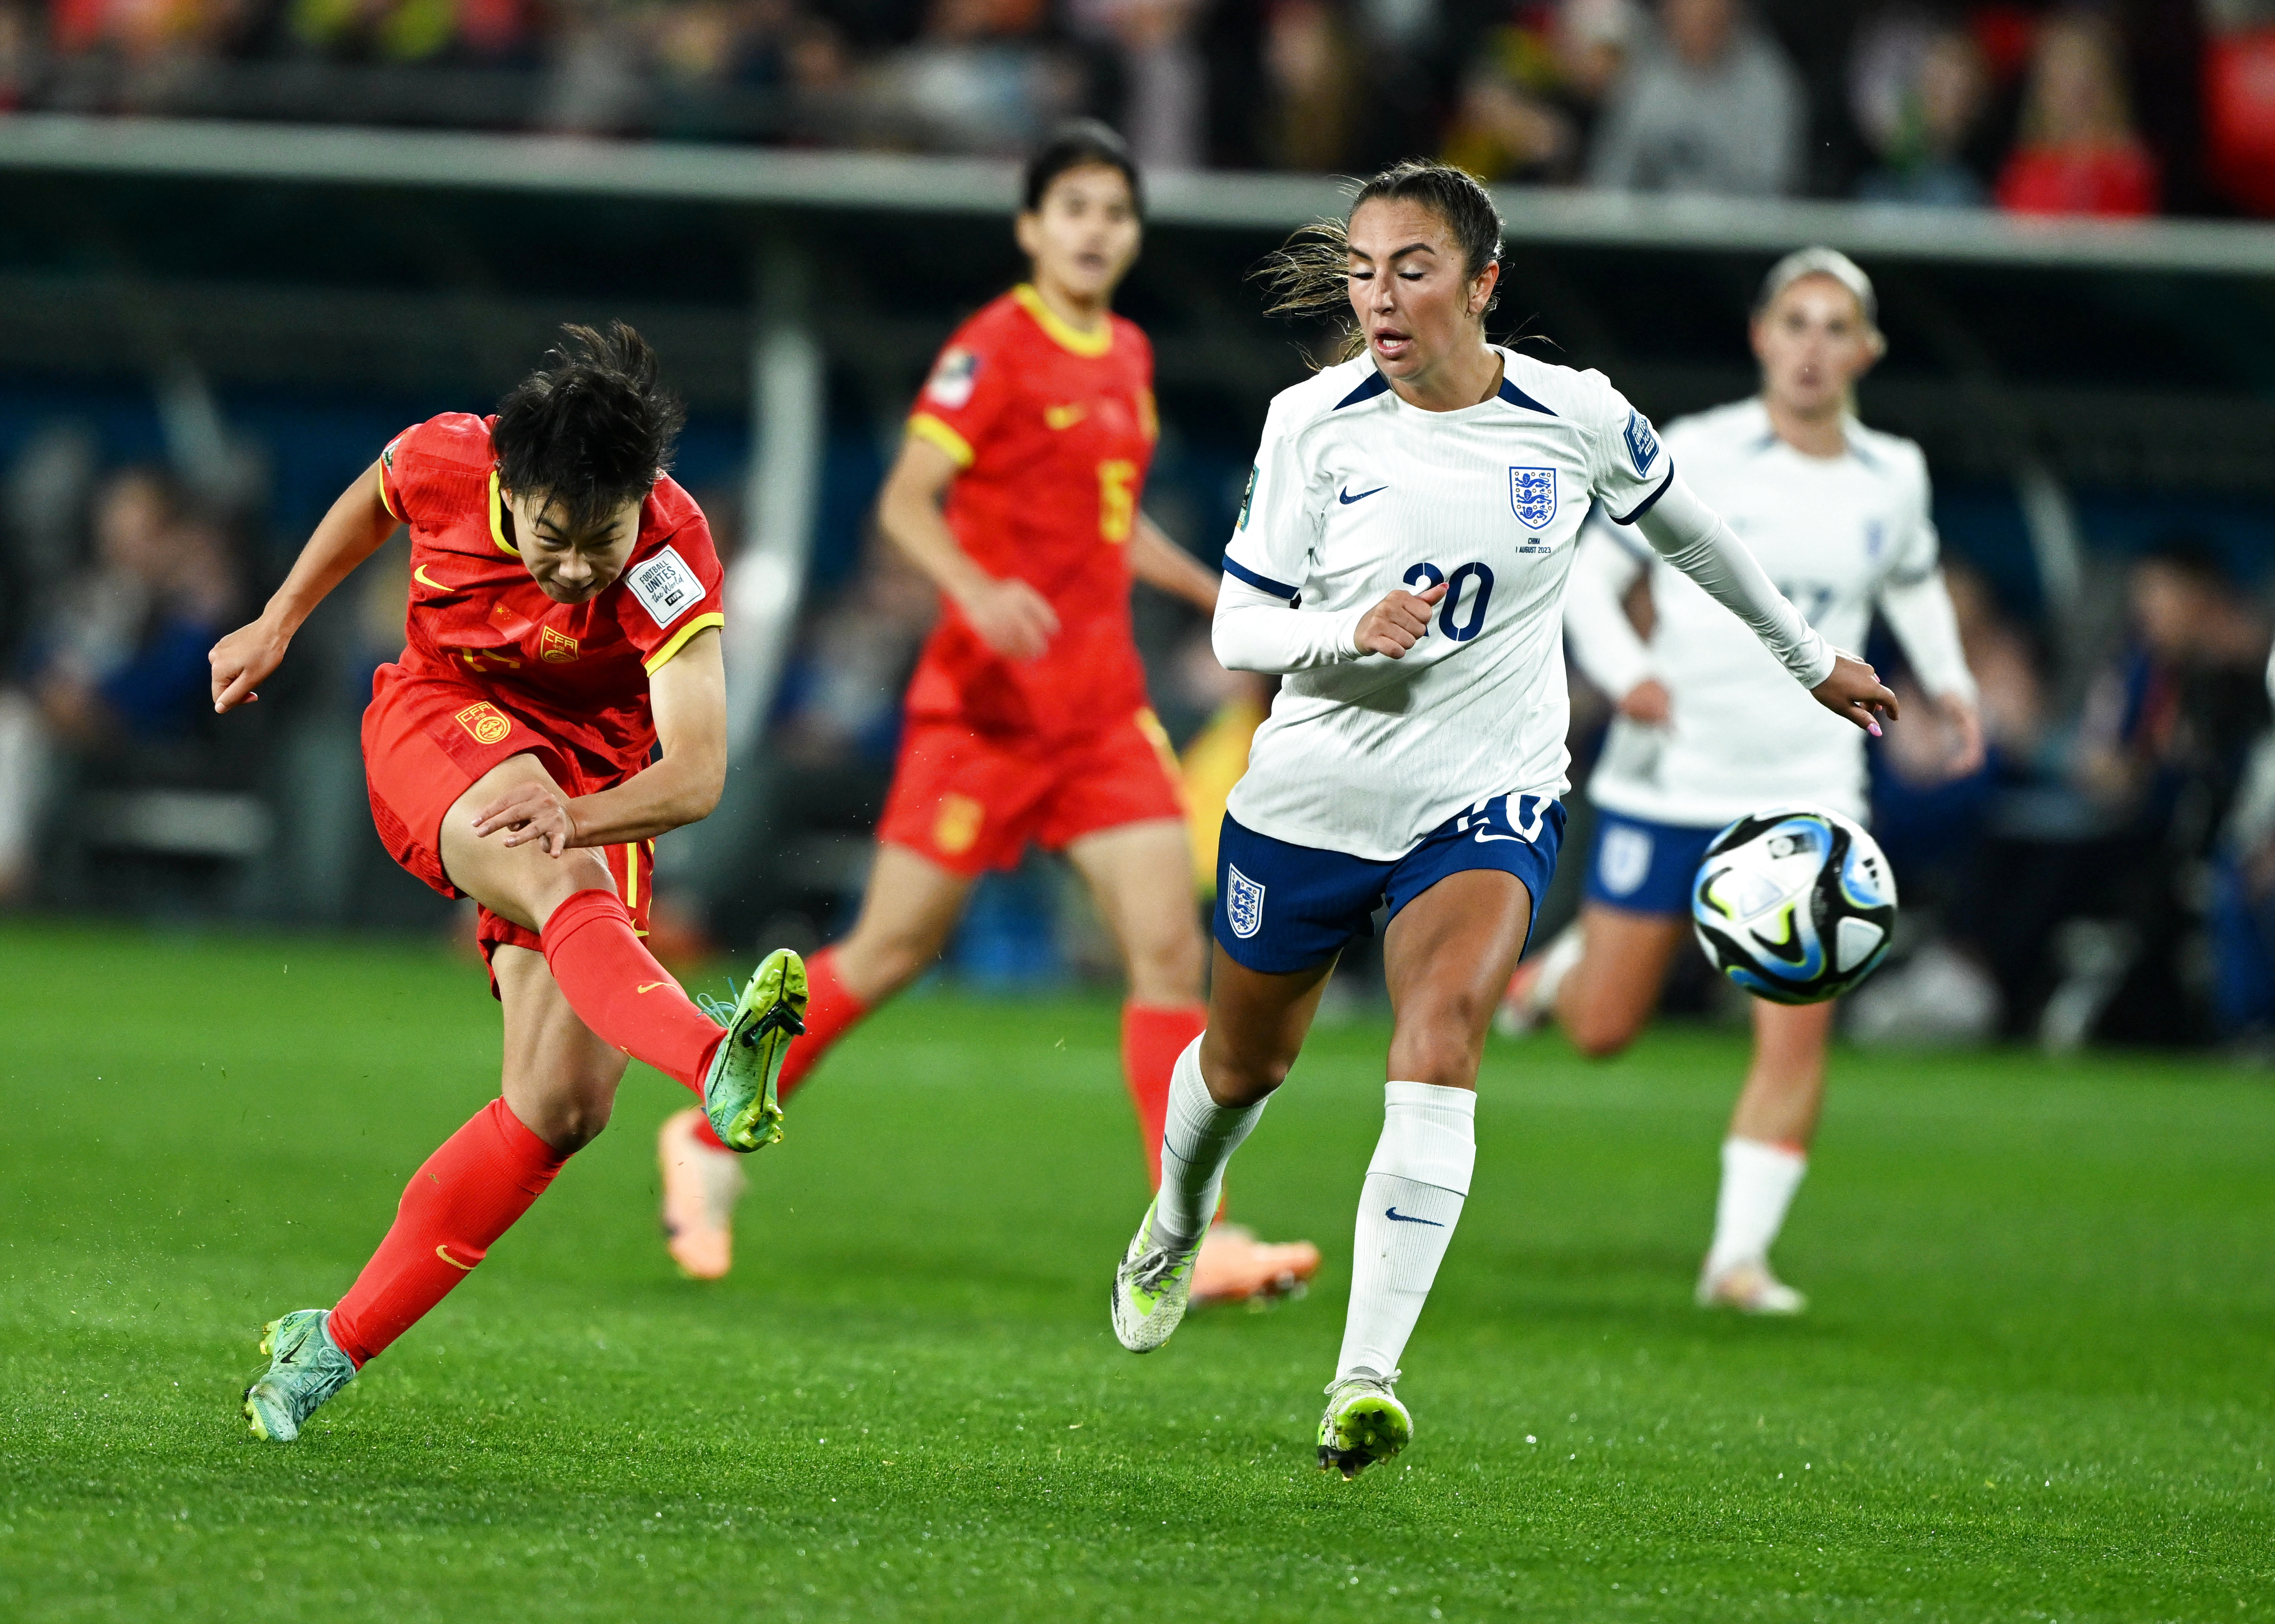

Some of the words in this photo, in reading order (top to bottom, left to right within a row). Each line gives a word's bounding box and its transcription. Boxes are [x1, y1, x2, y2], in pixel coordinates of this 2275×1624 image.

[1096, 459, 1136, 542] 5
[639, 560, 669, 585] FOOTBALL
[645, 566, 676, 593] UNITES
[651, 590, 664, 603] the
[661, 574, 684, 594] World
[667, 590, 684, 604] FIFA
[545, 631, 574, 649] CFA
[460, 703, 491, 723] CFA
